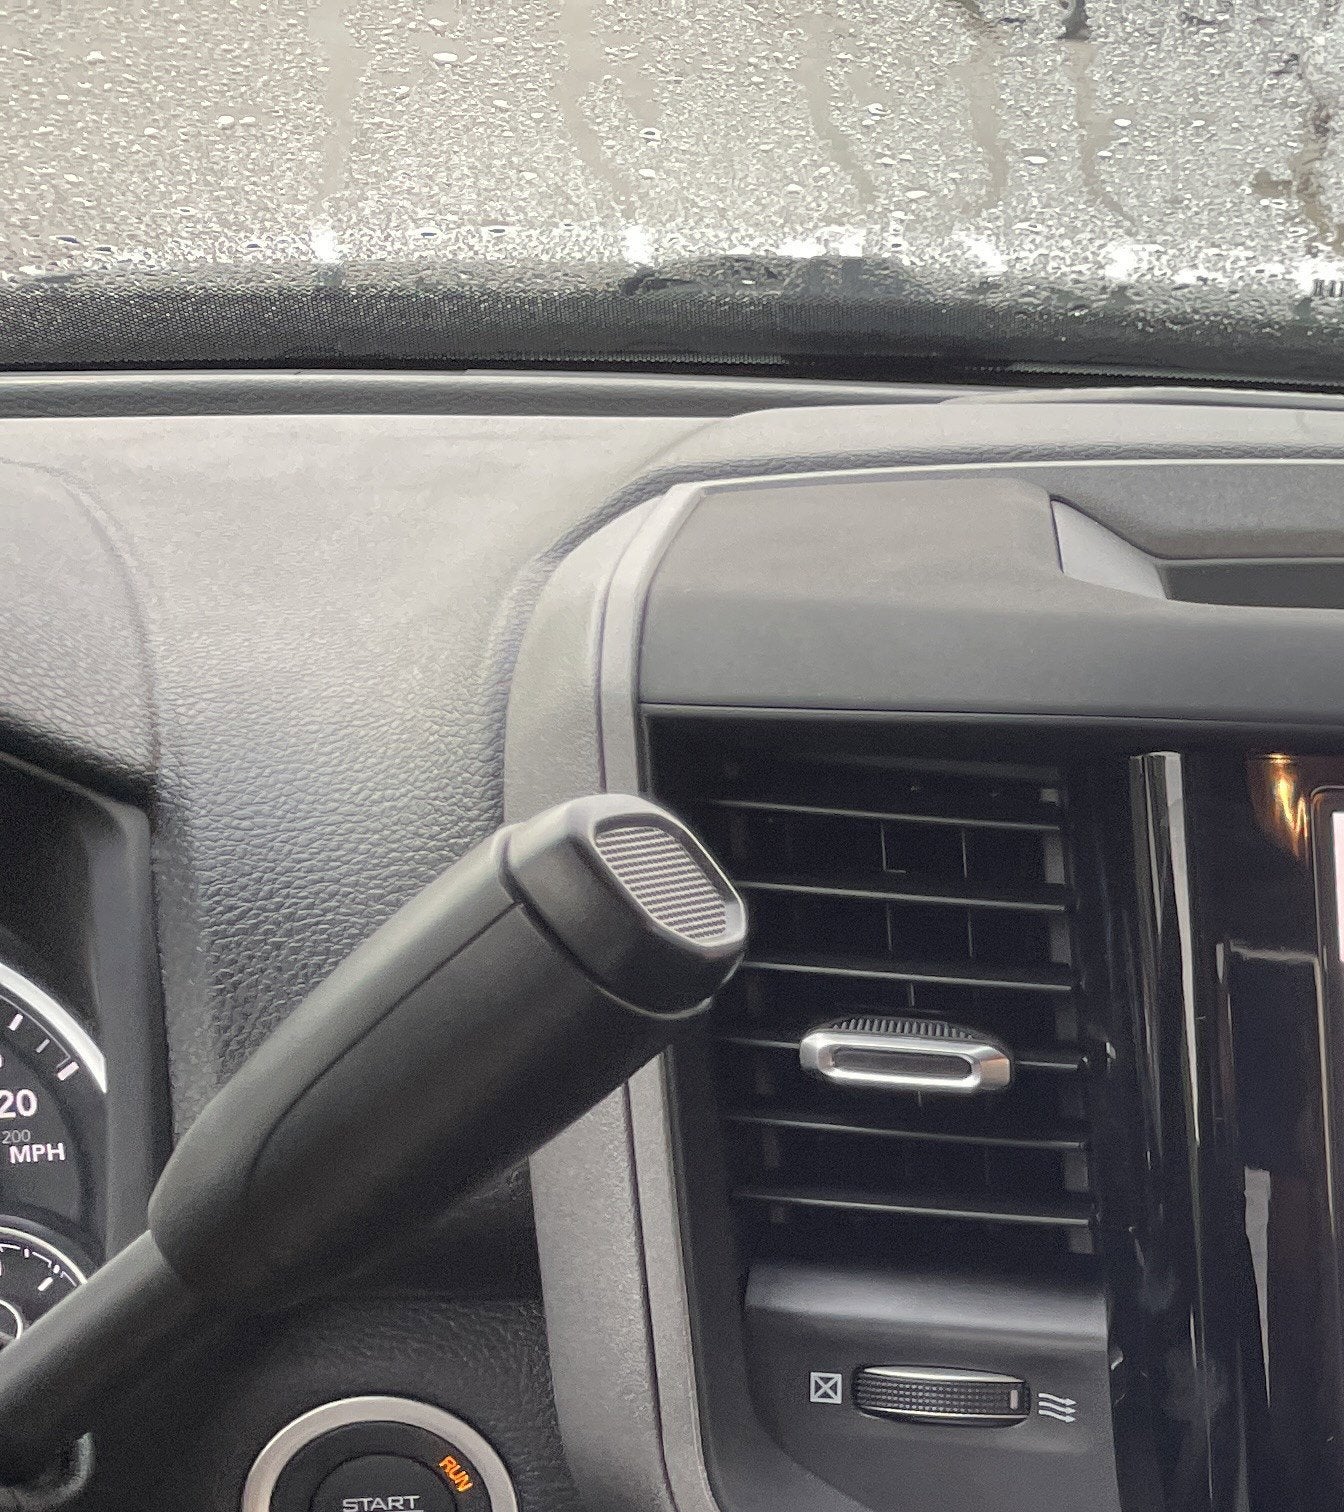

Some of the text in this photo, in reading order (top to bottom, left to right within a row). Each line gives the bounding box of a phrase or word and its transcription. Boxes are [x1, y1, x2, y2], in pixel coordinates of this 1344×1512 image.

[1, 1129, 31, 1144] 200
[9, 1142, 66, 1164] MPH
[438, 1455, 474, 1493] RUN
[342, 1495, 420, 1512] START
